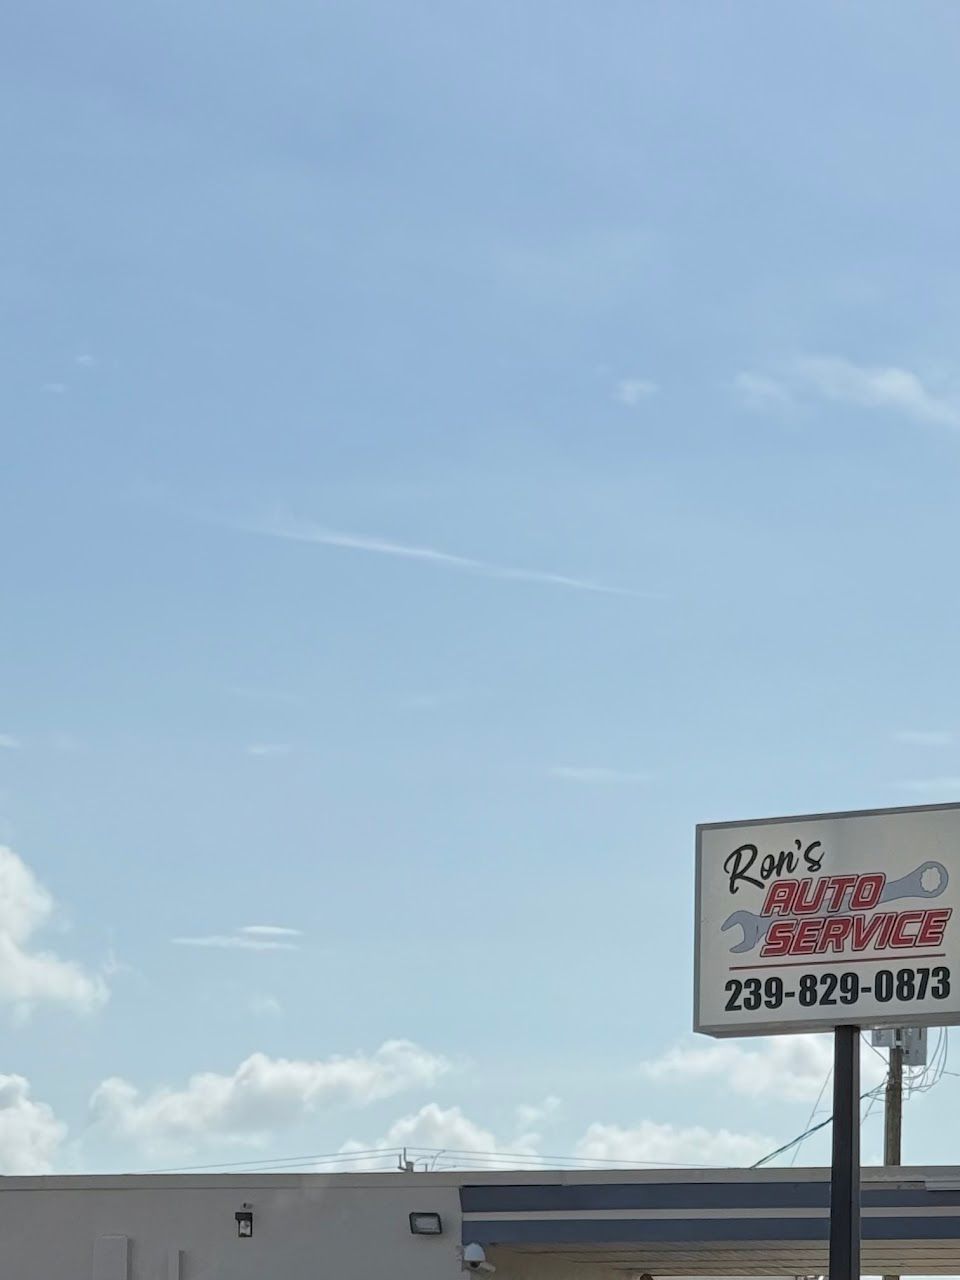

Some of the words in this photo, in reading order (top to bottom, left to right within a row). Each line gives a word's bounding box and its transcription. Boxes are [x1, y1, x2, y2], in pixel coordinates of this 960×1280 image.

[723, 840, 825, 893] Ron's
[761, 873, 886, 917] AUTO
[761, 909, 952, 957] SERVICE
[724, 967, 951, 1011] 239-829-0873
